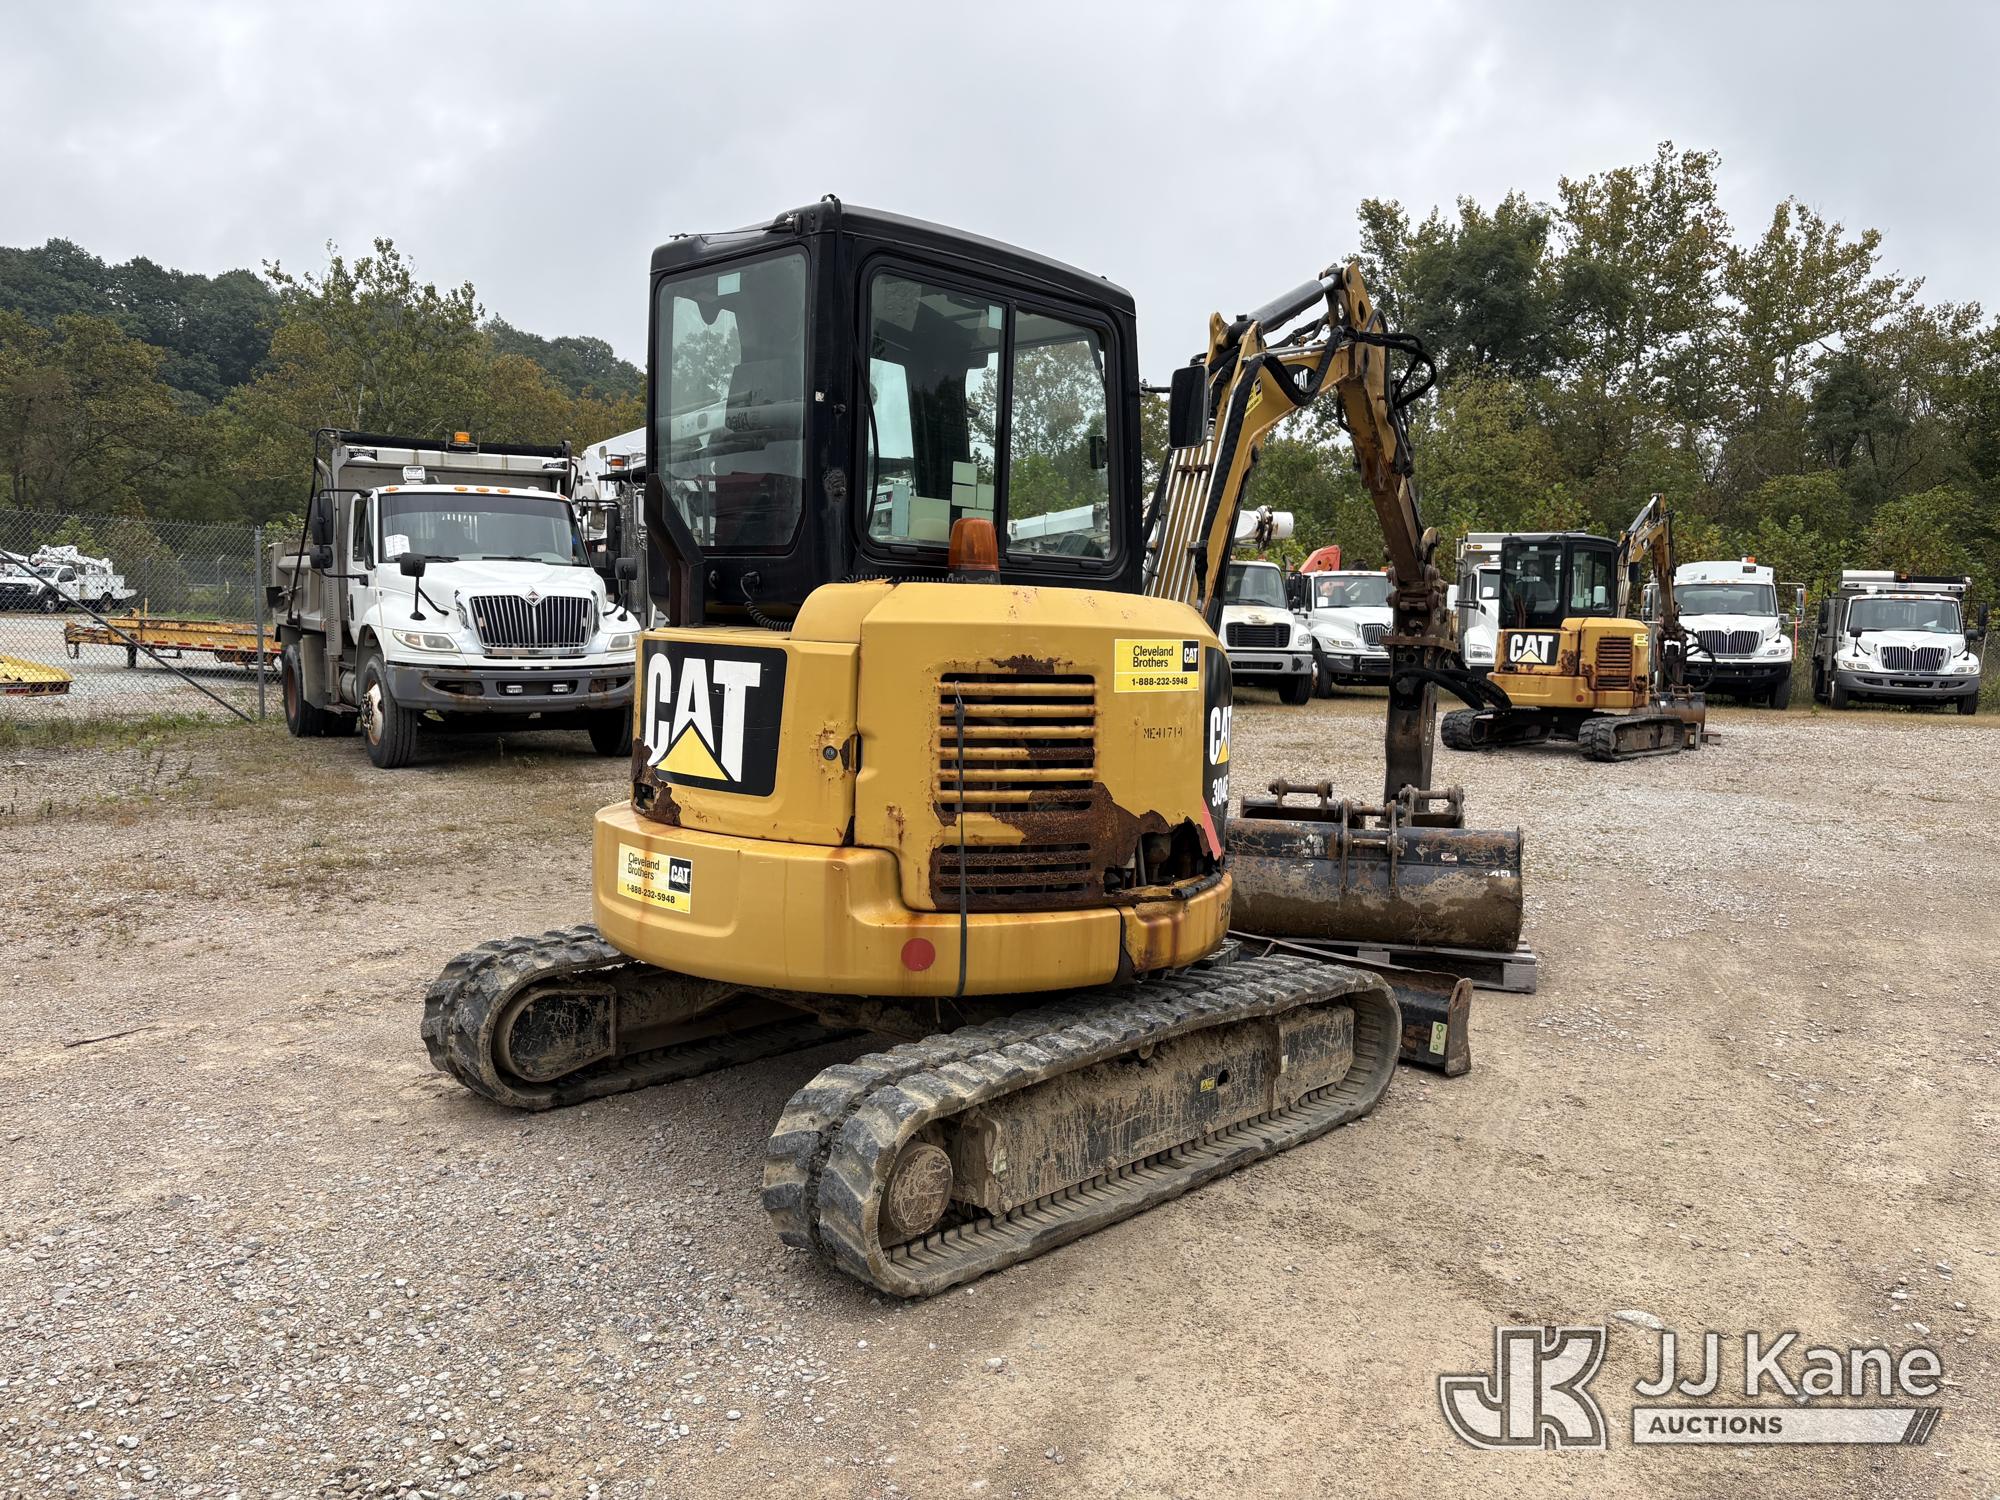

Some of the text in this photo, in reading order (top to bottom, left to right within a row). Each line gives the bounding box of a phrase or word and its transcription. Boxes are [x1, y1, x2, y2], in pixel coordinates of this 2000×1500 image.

[1133, 645, 1198, 664] Cleveland CAT
[1509, 634, 1553, 664] CAT
[1133, 656, 1169, 668] Brothers
[1131, 676, 1188, 686] 1-888-232-5948
[644, 652, 762, 783] CAT
[1209, 705, 1232, 765] CAT
[627, 862, 655, 880] Brothers
[628, 852, 691, 885] Cleveland CAT
[626, 883, 676, 904] 1-888-232-5948
